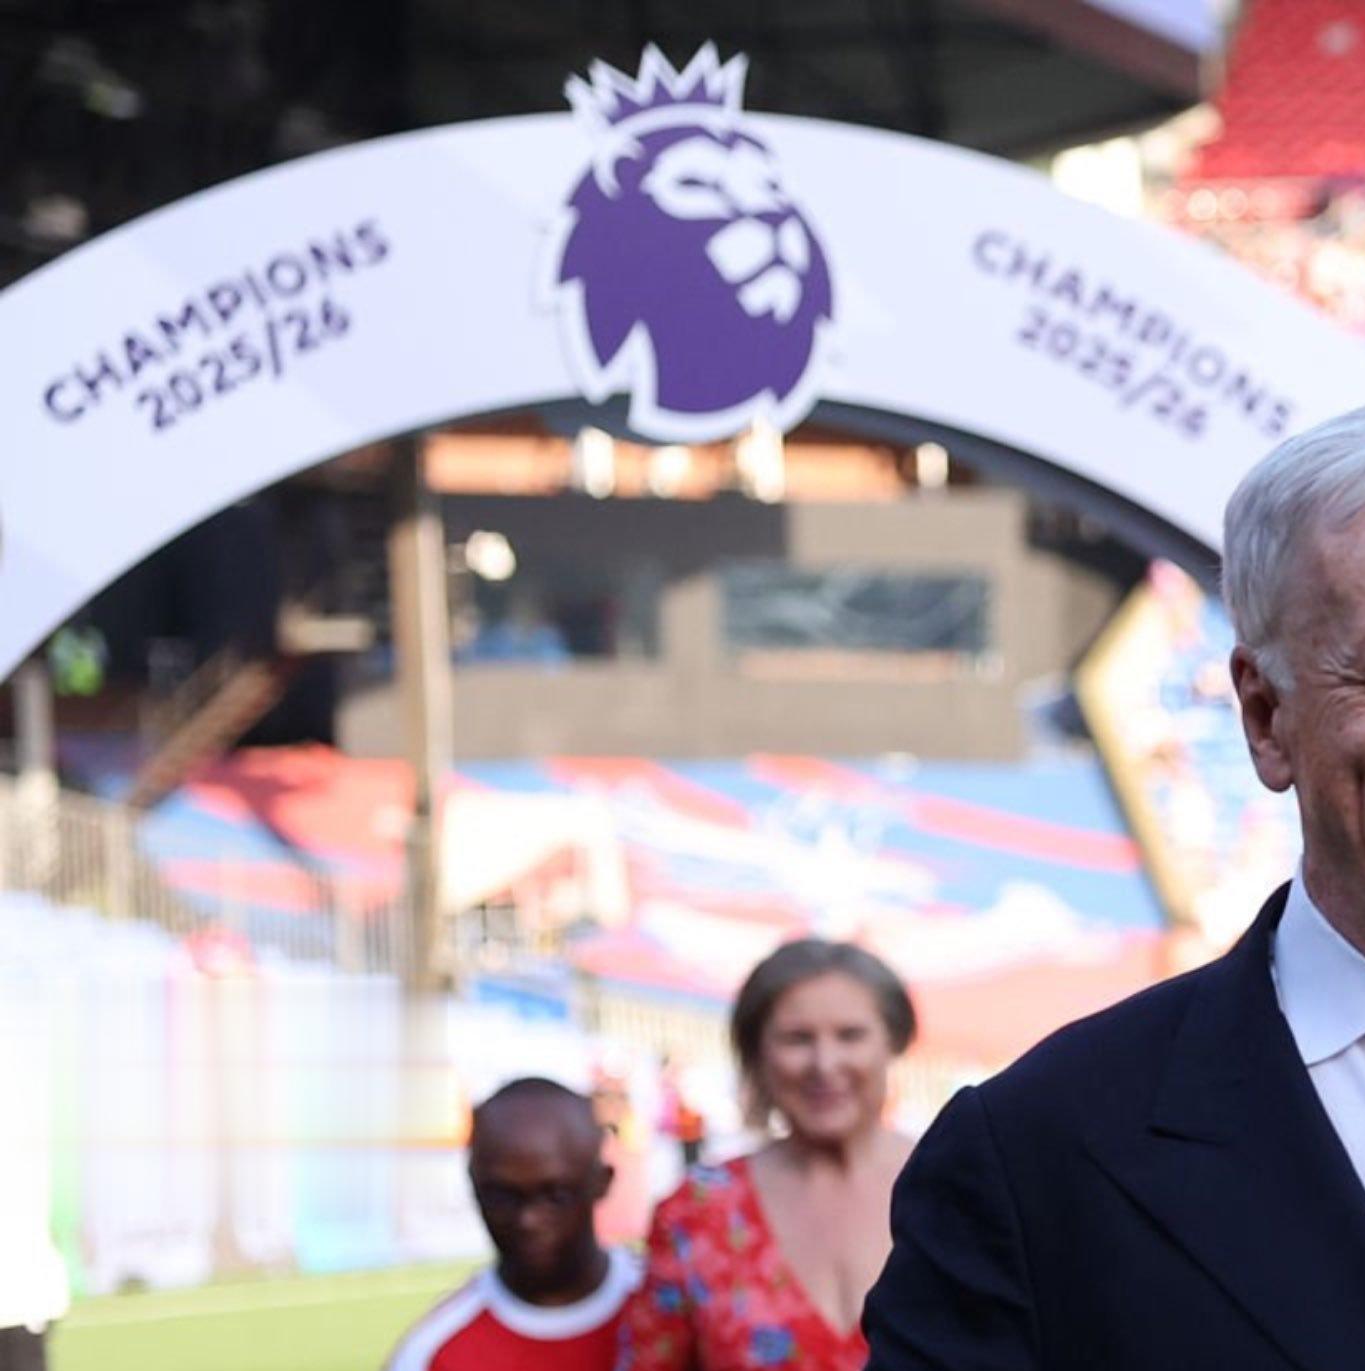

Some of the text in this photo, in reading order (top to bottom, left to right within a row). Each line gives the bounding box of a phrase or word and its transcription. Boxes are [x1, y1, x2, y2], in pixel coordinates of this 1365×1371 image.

[43, 219, 392, 422] CHAMPIONS
[137, 294, 351, 430] 2025/26
[971, 229, 1292, 437] CHAMPIONS
